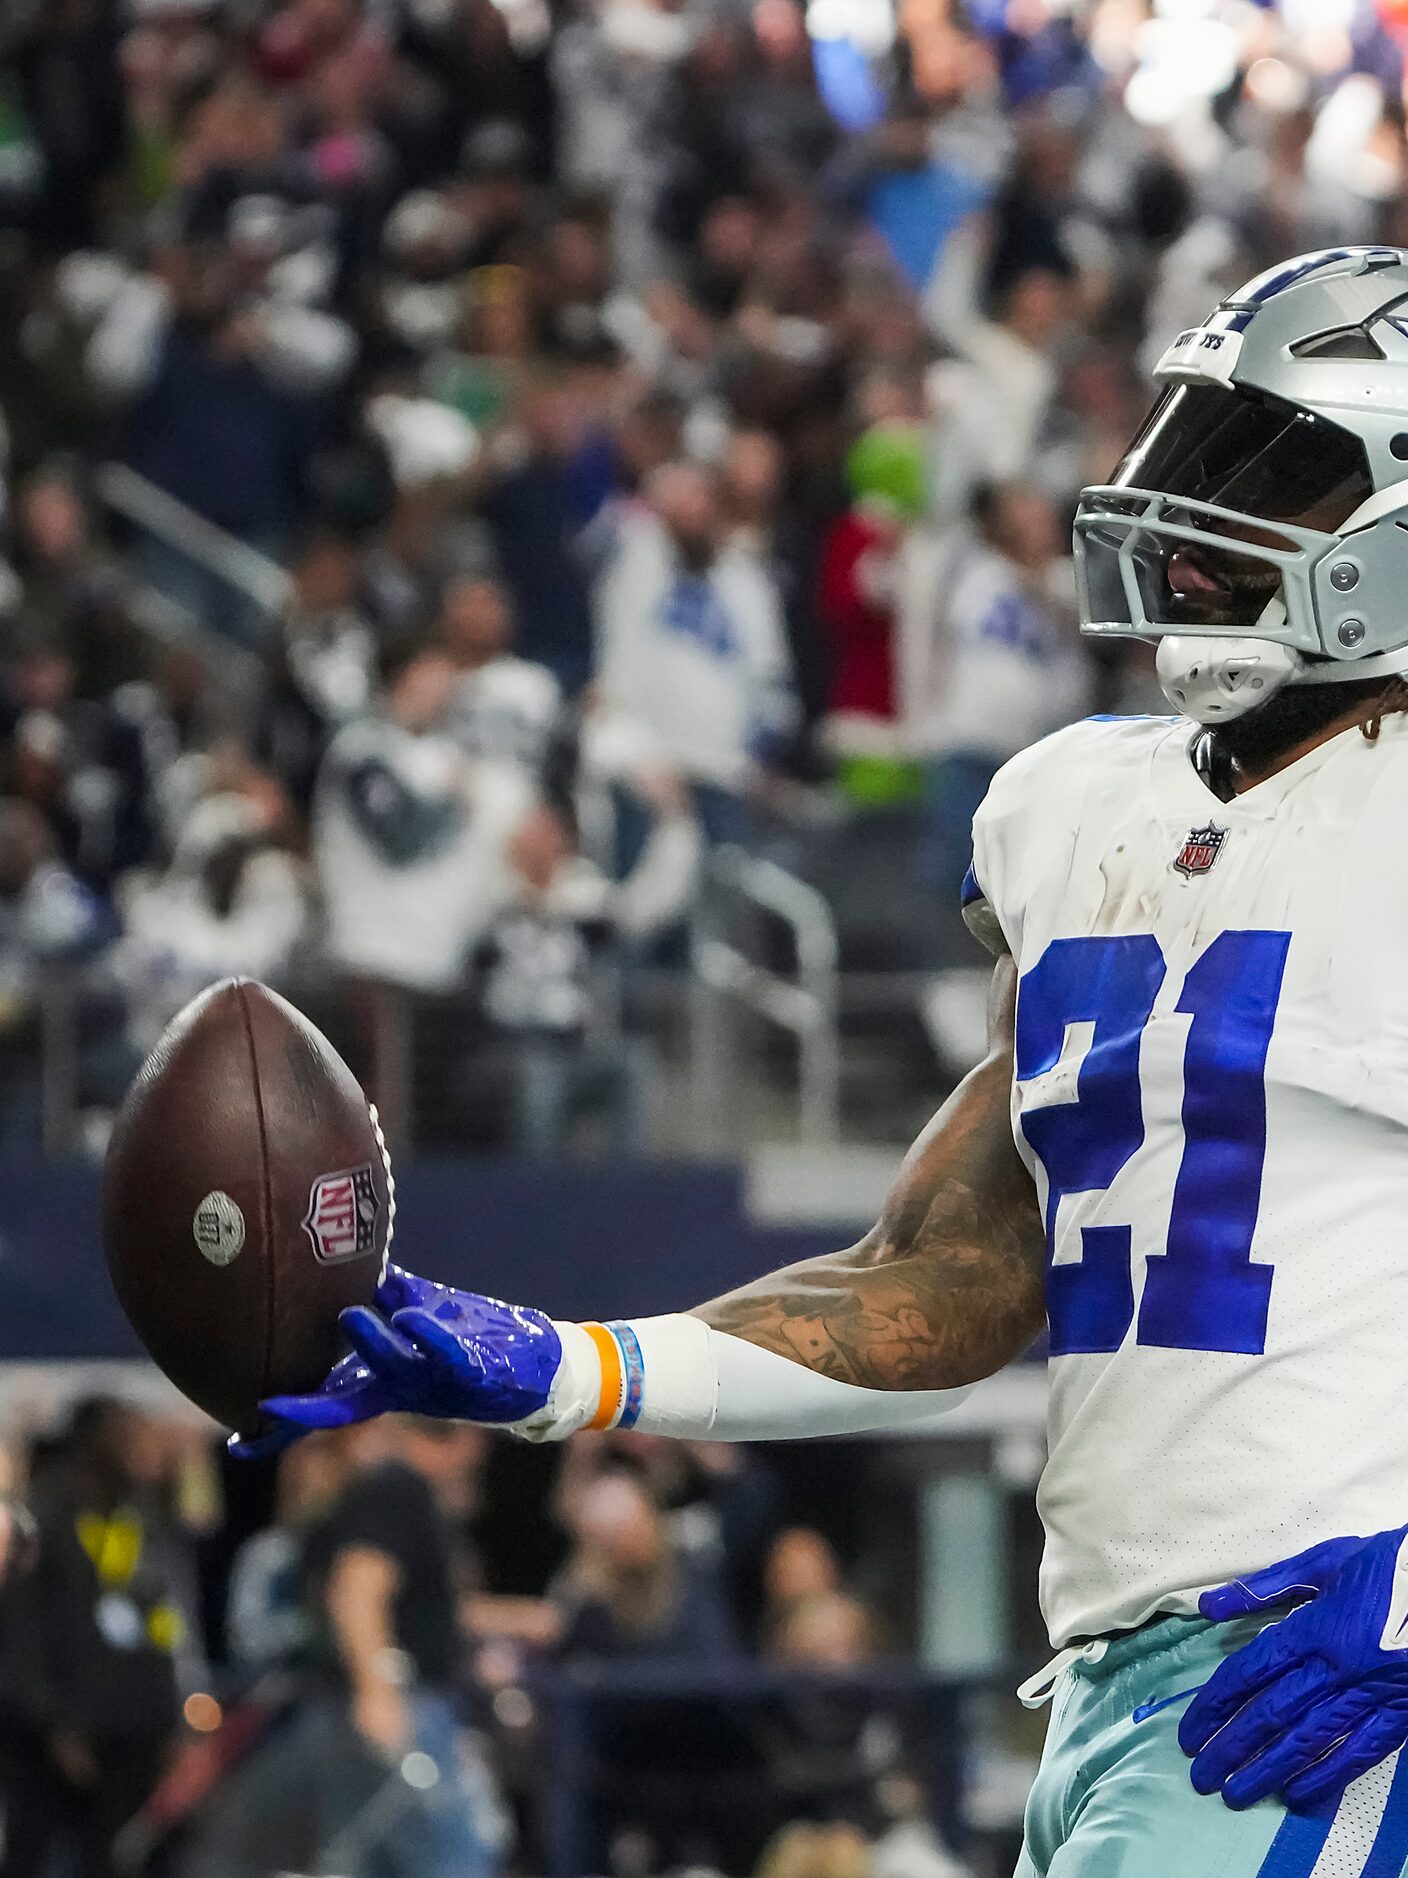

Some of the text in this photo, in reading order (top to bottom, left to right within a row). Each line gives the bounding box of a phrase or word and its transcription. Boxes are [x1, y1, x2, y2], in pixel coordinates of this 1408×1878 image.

[1178, 846, 1212, 869] NFL
[1015, 929, 1293, 1356] 21
[317, 1181, 356, 1254] NFL
